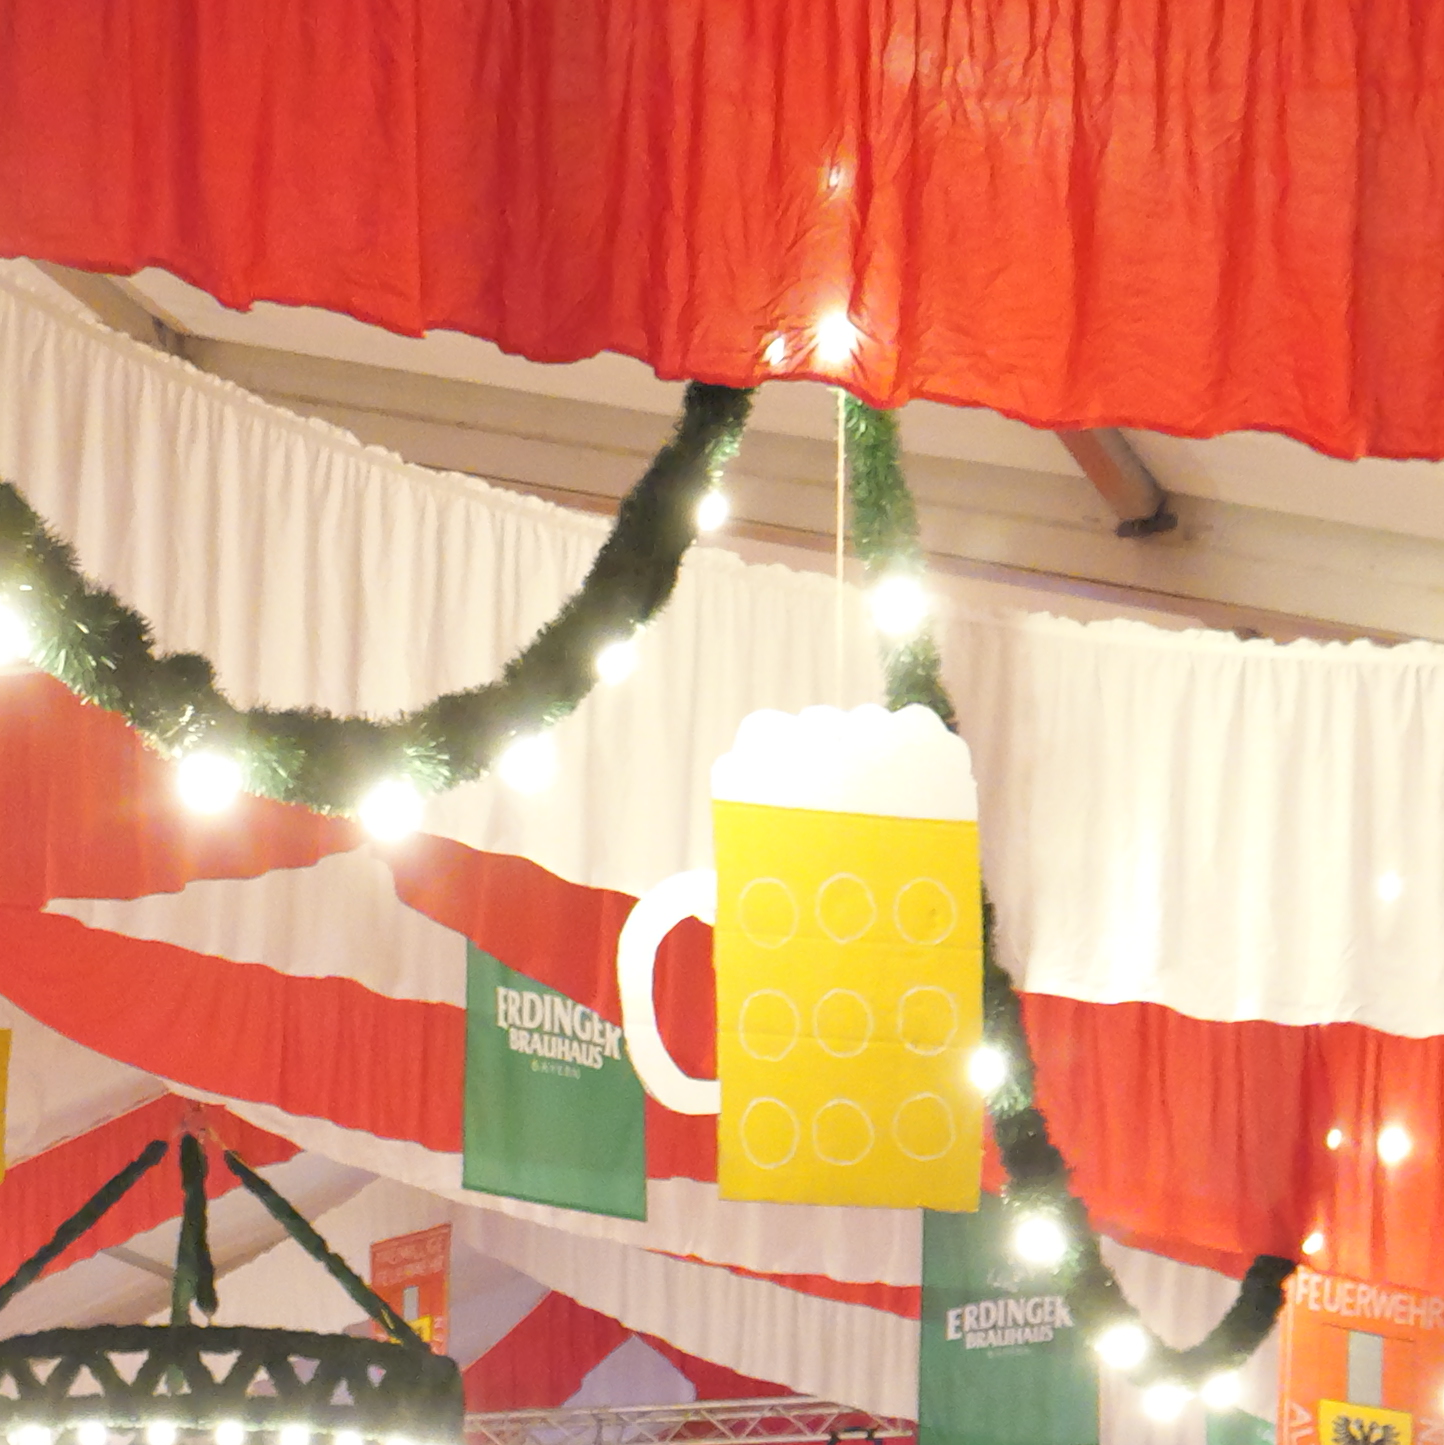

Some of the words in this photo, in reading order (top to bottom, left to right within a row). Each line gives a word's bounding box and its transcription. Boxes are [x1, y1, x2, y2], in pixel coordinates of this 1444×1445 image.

[496, 985, 622, 1060] ERDINGER
[508, 1027, 604, 1070] BRAUHAUS
[945, 1295, 1074, 1341] ERDINGER
